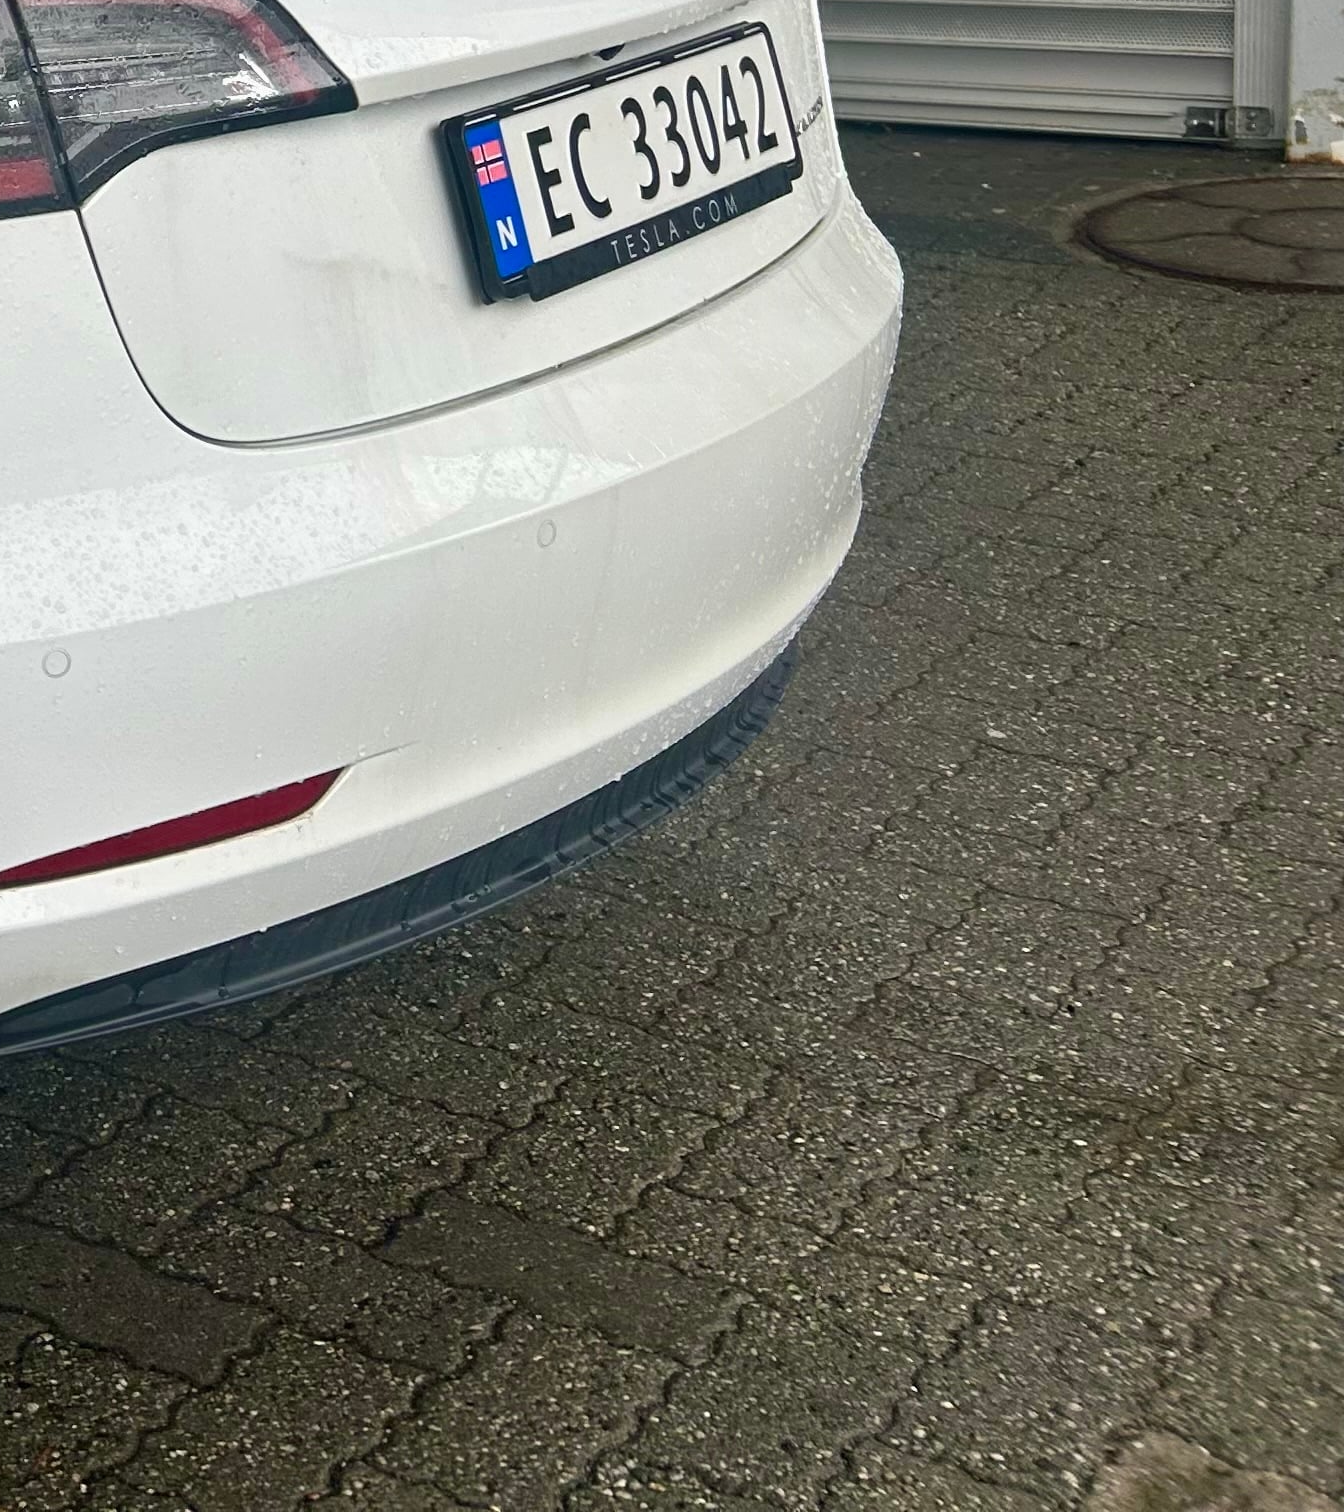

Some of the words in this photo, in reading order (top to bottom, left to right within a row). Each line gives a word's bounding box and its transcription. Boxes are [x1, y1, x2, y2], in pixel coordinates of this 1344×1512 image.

[526, 112, 612, 237] EC
[620, 55, 779, 200] 33042
[496, 216, 518, 251] N
[611, 194, 738, 265] TESLA.COM
